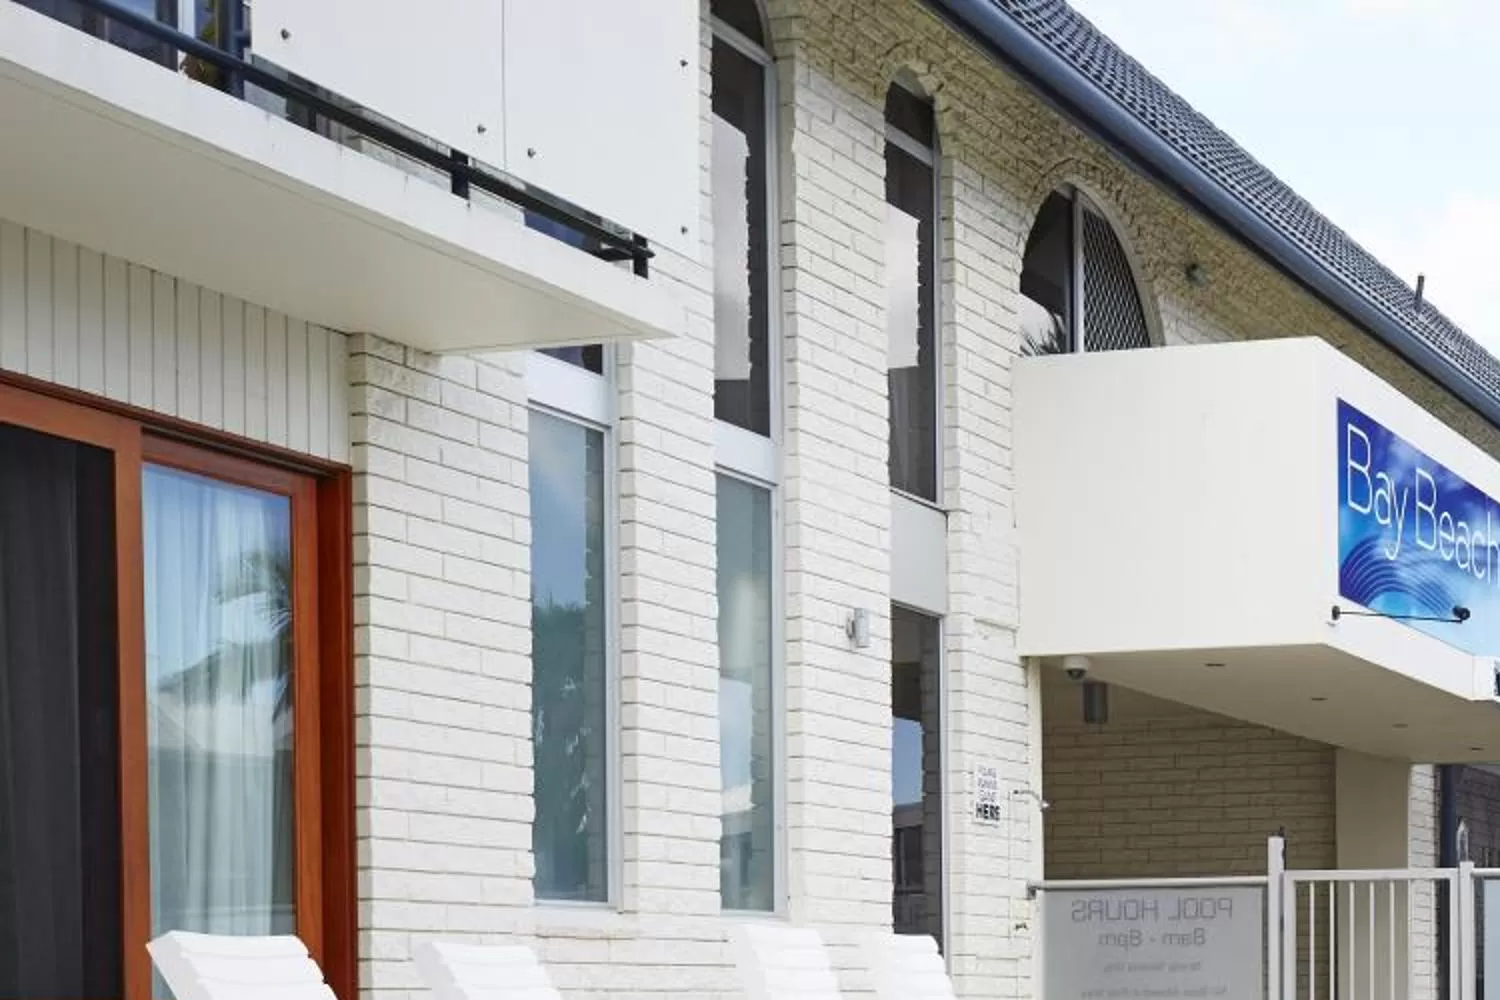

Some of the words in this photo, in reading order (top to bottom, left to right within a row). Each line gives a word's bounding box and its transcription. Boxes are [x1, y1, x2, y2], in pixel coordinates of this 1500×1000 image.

[1347, 423, 1408, 561] Bay
[1415, 467, 1500, 588] Beach
[976, 802, 1001, 821] HERE
